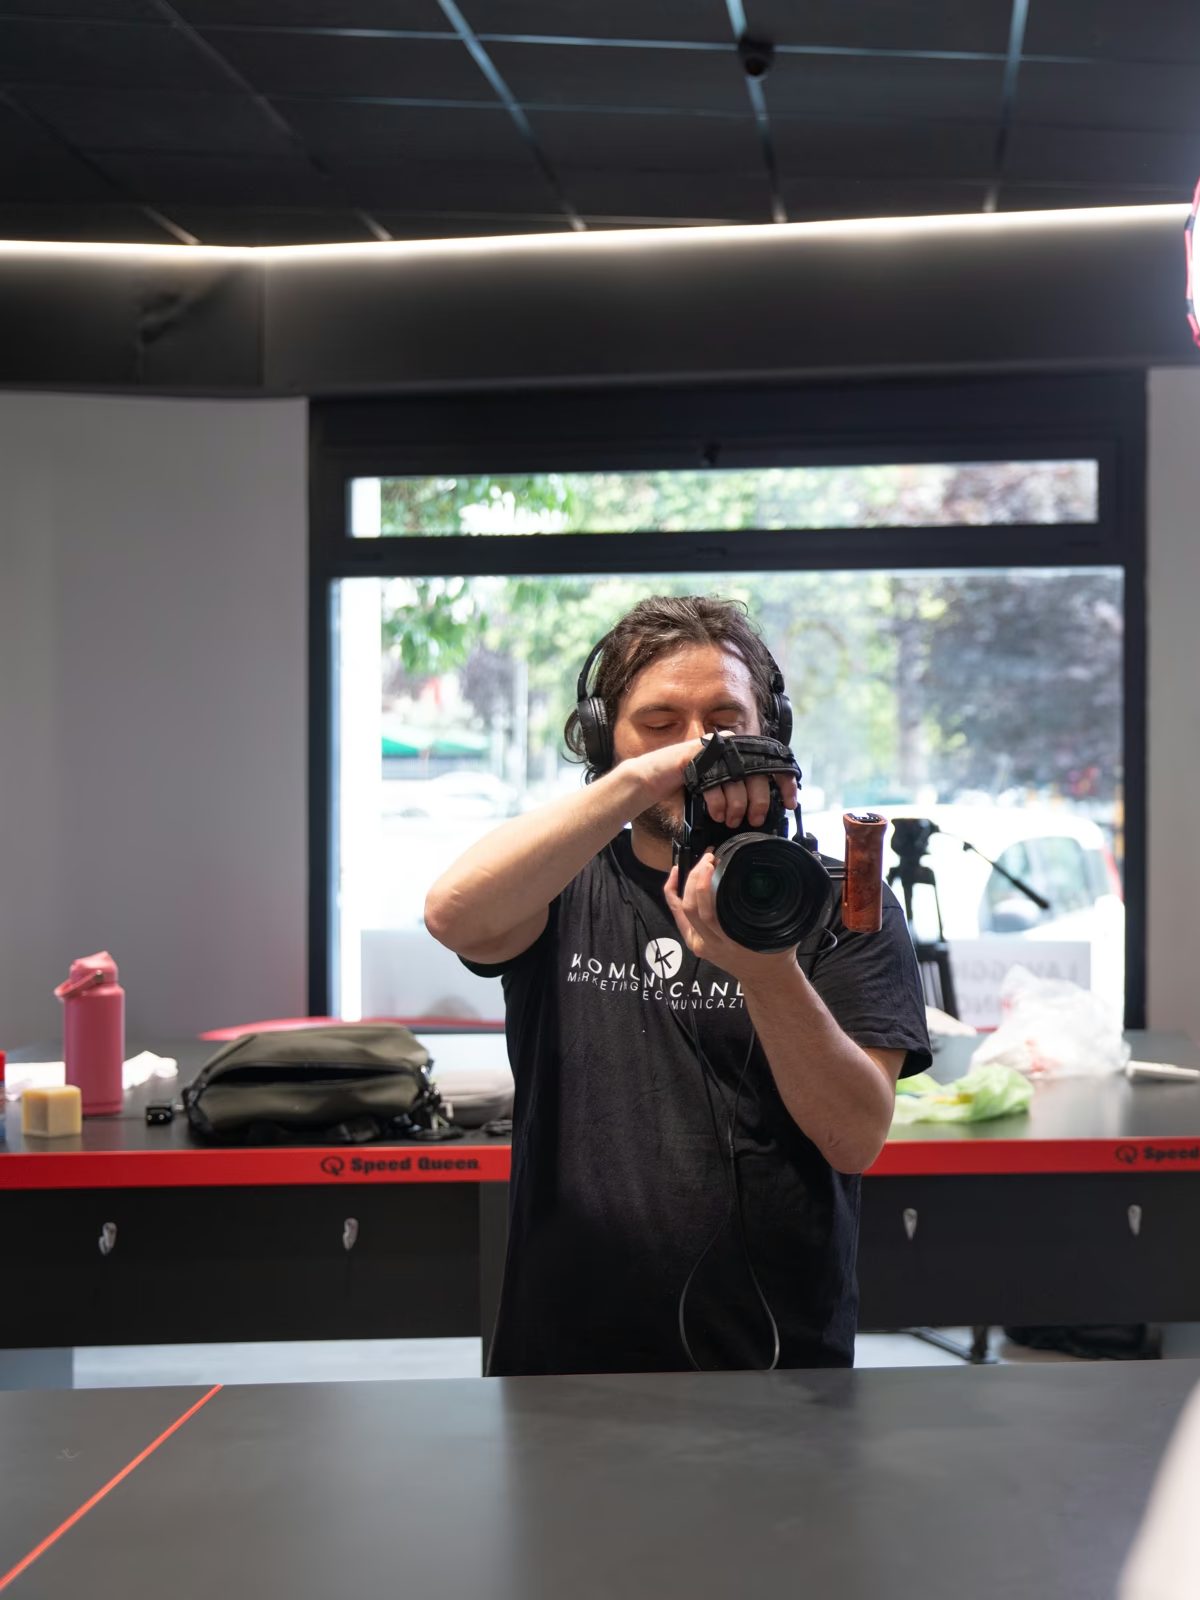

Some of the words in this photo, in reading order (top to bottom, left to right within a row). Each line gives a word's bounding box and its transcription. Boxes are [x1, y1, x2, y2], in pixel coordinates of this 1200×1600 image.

[1143, 1146, 1199, 1162] Speed
[351, 1156, 411, 1174] Speed
[418, 1156, 479, 1171] Queen
